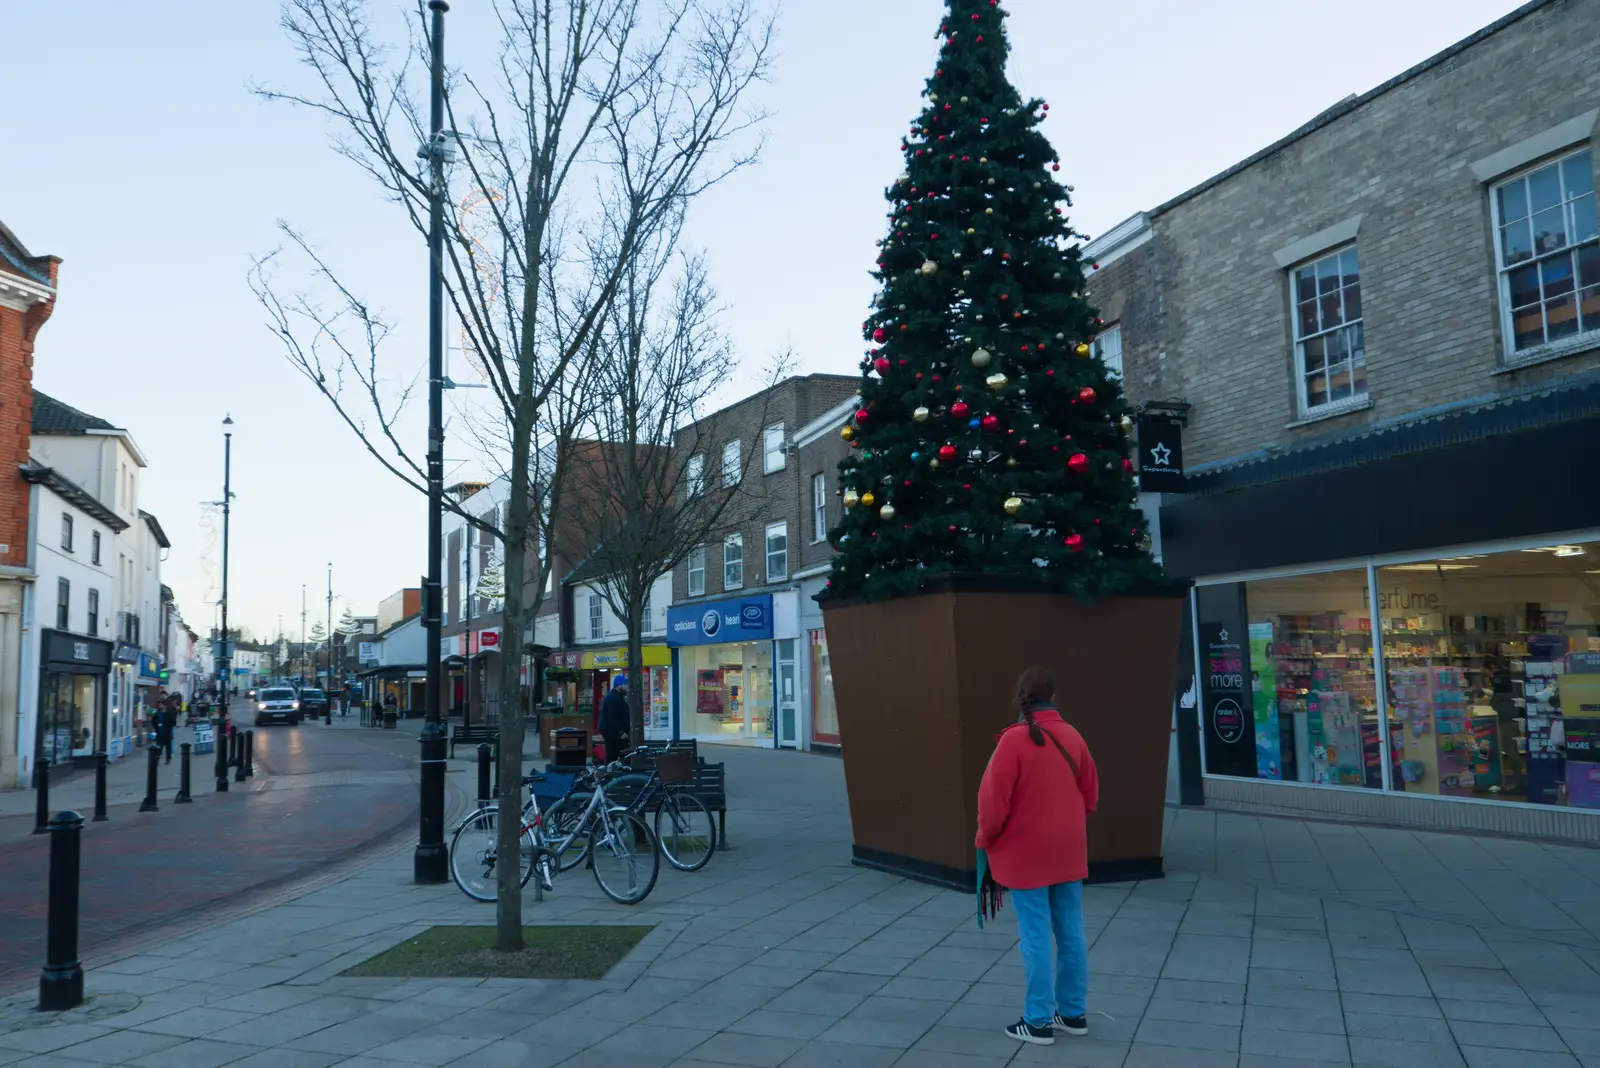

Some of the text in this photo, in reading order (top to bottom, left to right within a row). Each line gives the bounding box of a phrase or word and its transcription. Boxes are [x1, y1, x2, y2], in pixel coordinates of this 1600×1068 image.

[1142, 465, 1180, 474] Superdrug
[674, 620, 697, 632] opticians
[1210, 659, 1242, 672] save
[1211, 674, 1243, 688] more
[1567, 742, 1591, 750] MORE
